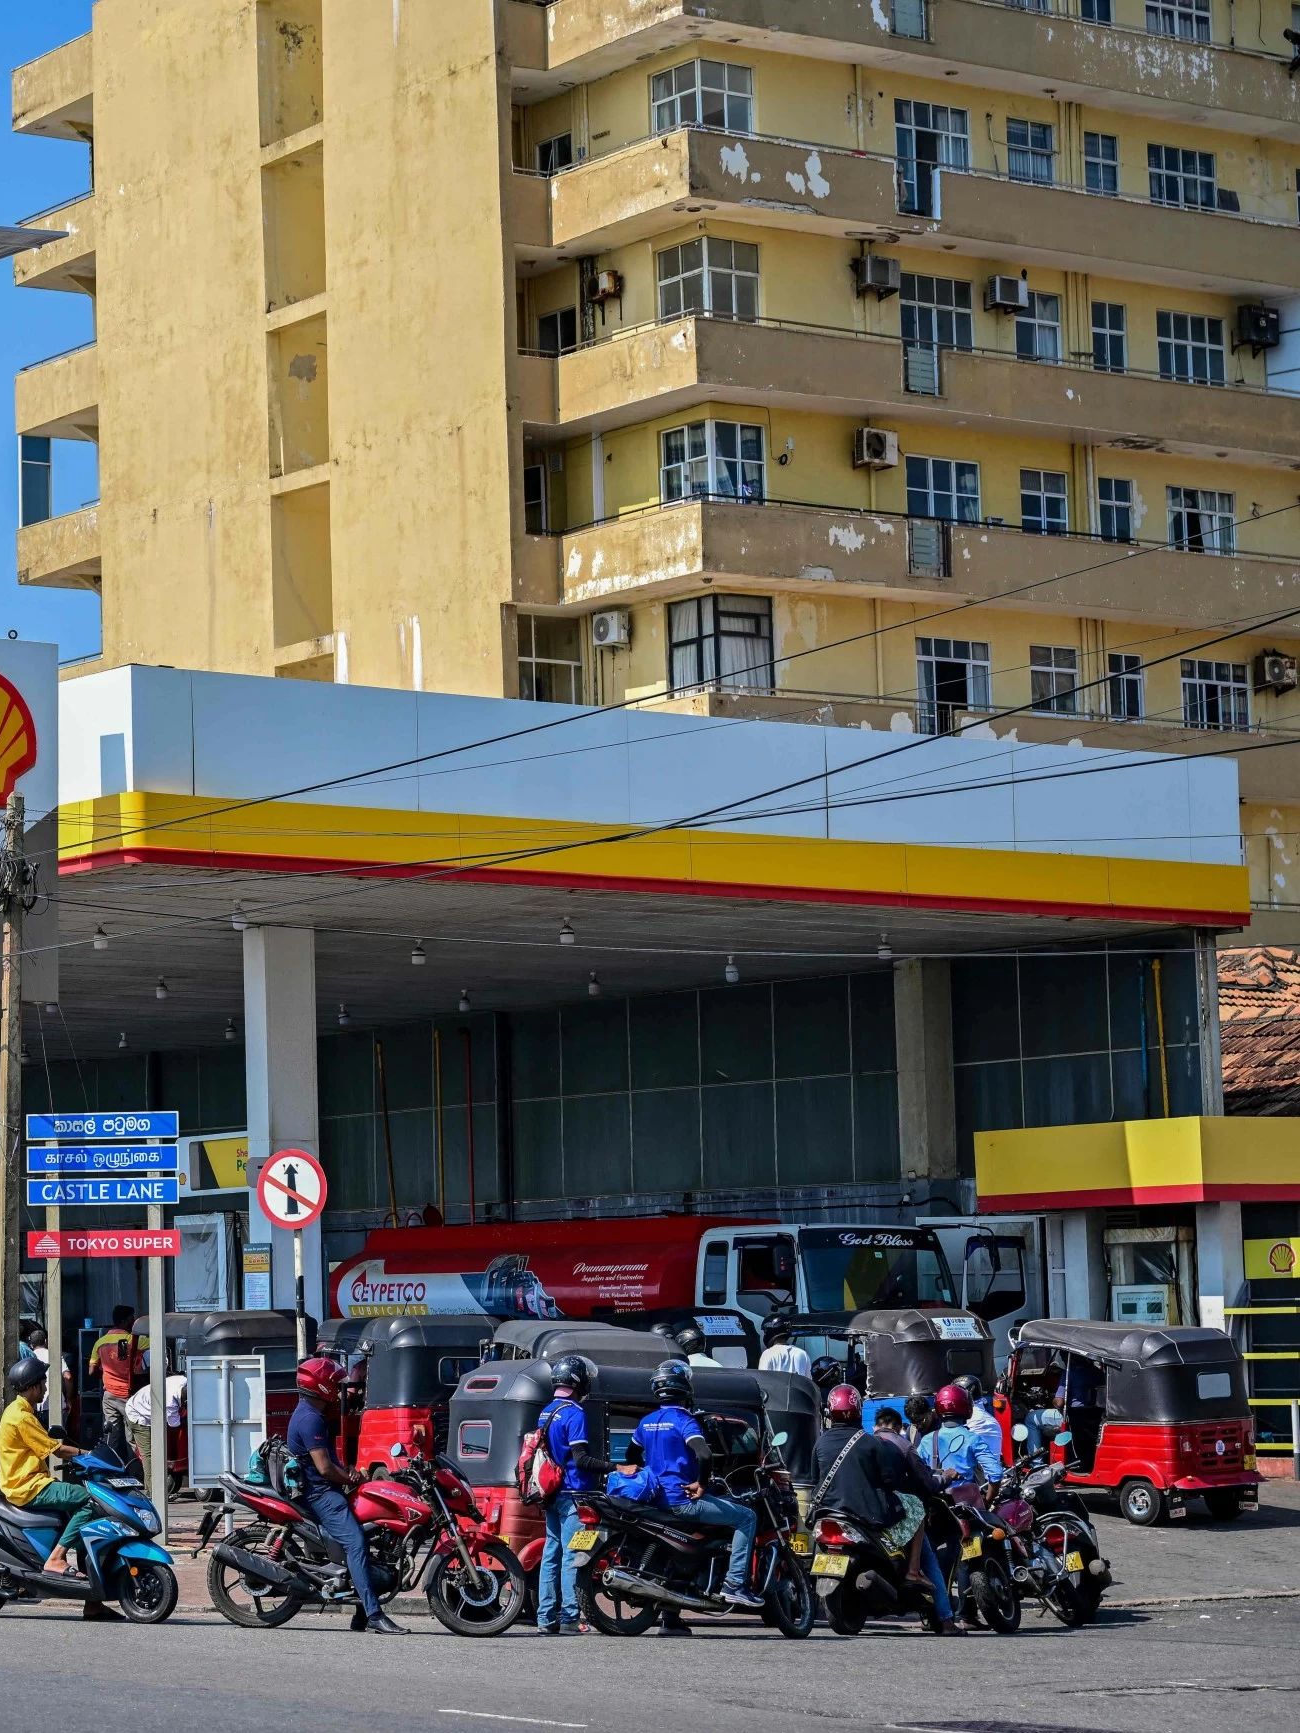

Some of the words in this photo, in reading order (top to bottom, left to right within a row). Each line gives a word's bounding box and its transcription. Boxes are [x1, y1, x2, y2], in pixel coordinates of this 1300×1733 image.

[45, 1149, 87, 1164] காசல்
[41, 1183, 110, 1201] CASTLE
[116, 1182, 164, 1200] LANE
[67, 1238, 119, 1250] TOKYO
[123, 1237, 173, 1249] SUPER
[838, 1232, 872, 1246] God
[873, 1233, 913, 1247] Bless
[351, 1281, 426, 1303] CEYPETCO
[350, 1303, 428, 1316] LUBRICANTS
